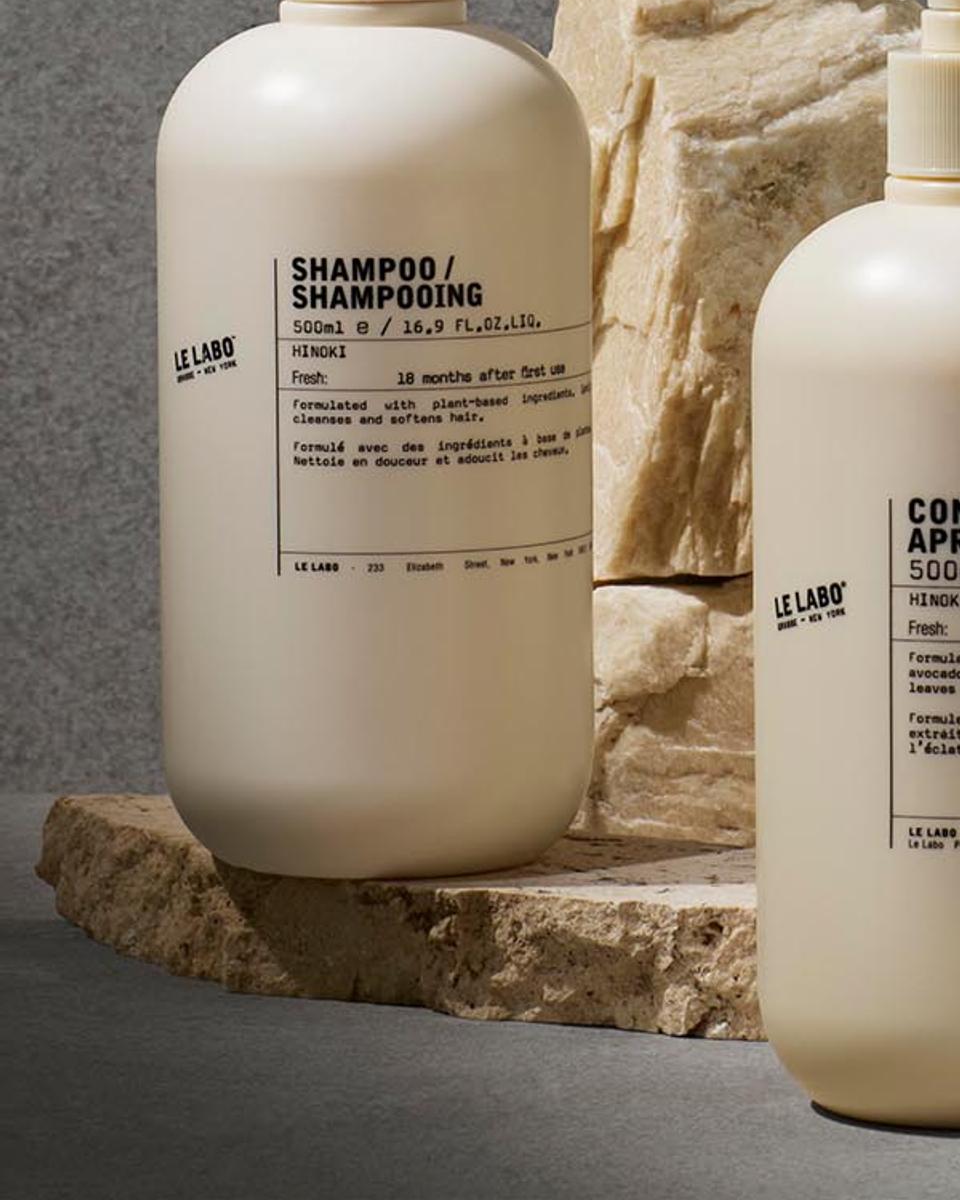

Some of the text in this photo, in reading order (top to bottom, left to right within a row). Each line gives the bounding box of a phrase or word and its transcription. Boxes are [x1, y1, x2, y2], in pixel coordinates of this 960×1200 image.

[292, 282, 483, 310] SHAMPOOING
[293, 320, 344, 335] 500ml
[403, 319, 444, 335] 16.9
[292, 344, 346, 359] HINOKI
[174, 348, 190, 372] LE
[292, 370, 327, 385] Fresh:
[397, 372, 415, 385] 18
[422, 370, 472, 385] months
[479, 367, 516, 382] after
[521, 364, 546, 379] first
[384, 400, 416, 411] with
[432, 396, 508, 411] plant-based
[293, 411, 484, 425] cleanses and softens hair.
[358, 444, 388, 453] avec
[402, 442, 425, 452] des
[438, 438, 512, 453] ingrédients
[293, 456, 345, 467] Nettoie
[352, 458, 368, 467] en
[375, 456, 428, 467] douceur
[435, 454, 450, 465] et
[457, 452, 504, 464] adoucit
[368, 563, 385, 573] 233
[774, 594, 792, 618] LE
[808, 608, 846, 623] NEW YORK
[908, 620, 948, 636] Fresh:
[909, 682, 956, 694] leaves
[909, 827, 924, 838] LE
[927, 827, 957, 838] LABO
[909, 840, 919, 849] Le
[922, 840, 945, 849] Labo
